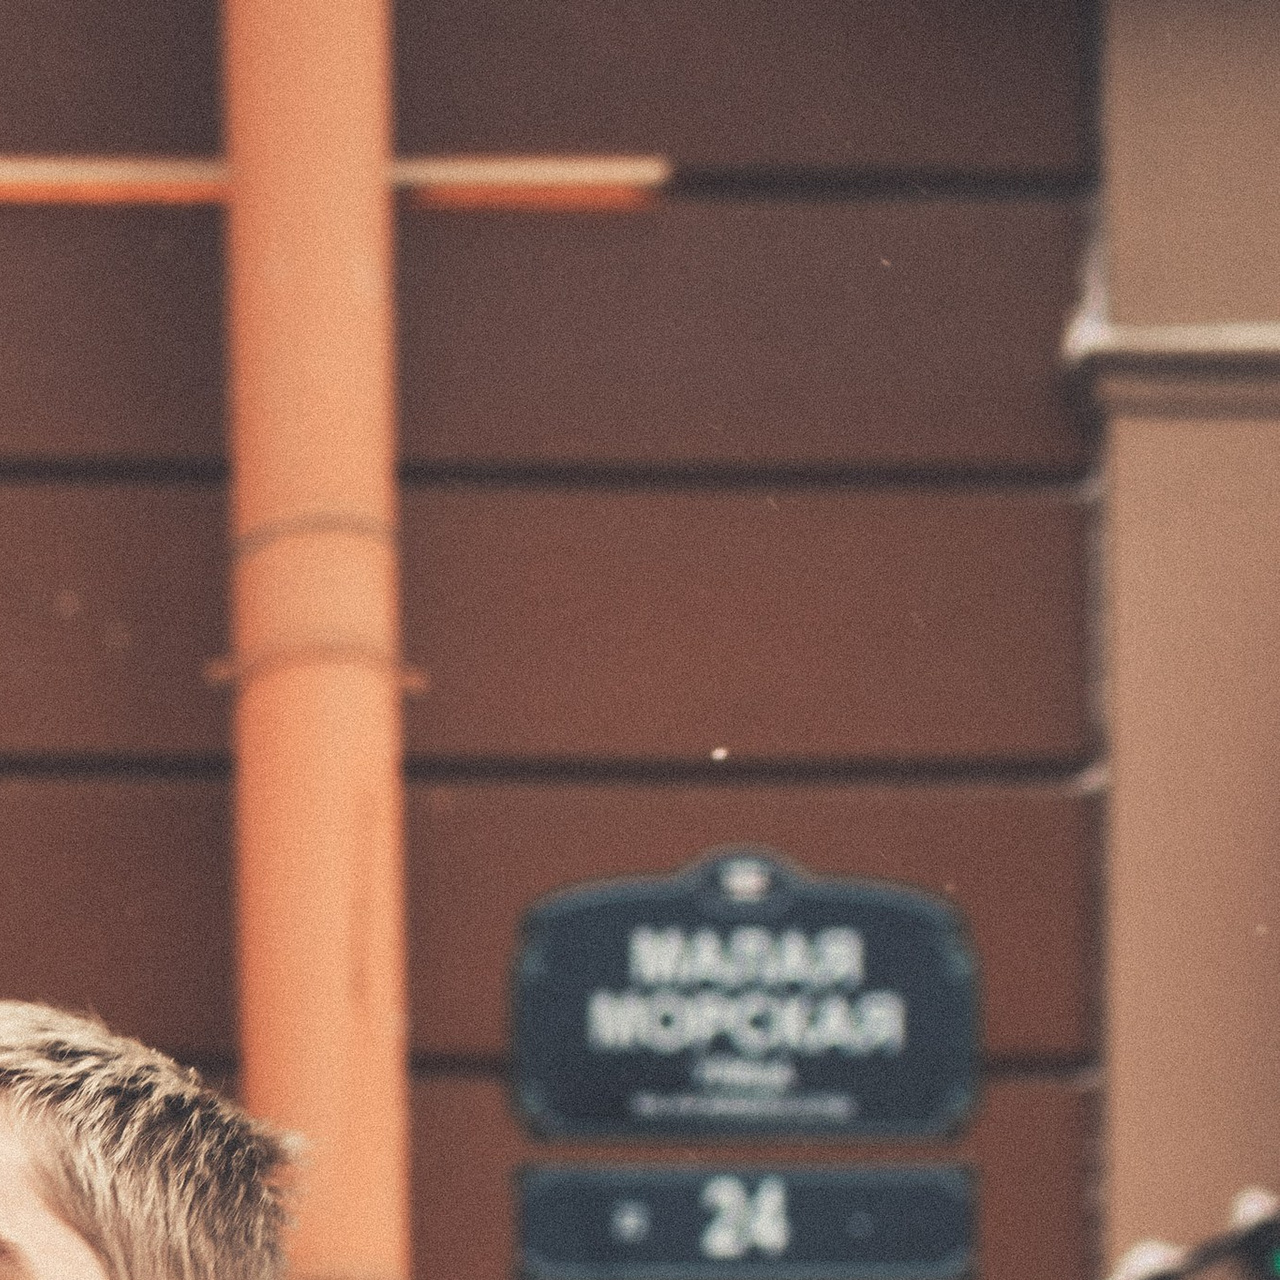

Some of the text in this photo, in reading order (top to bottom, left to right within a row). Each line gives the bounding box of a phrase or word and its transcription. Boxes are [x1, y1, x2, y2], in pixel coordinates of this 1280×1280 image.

[629, 926, 863, 987] МАЛАЯ
[587, 991, 906, 1054] МОРСКАЯ
[700, 1175, 790, 1259] 24
